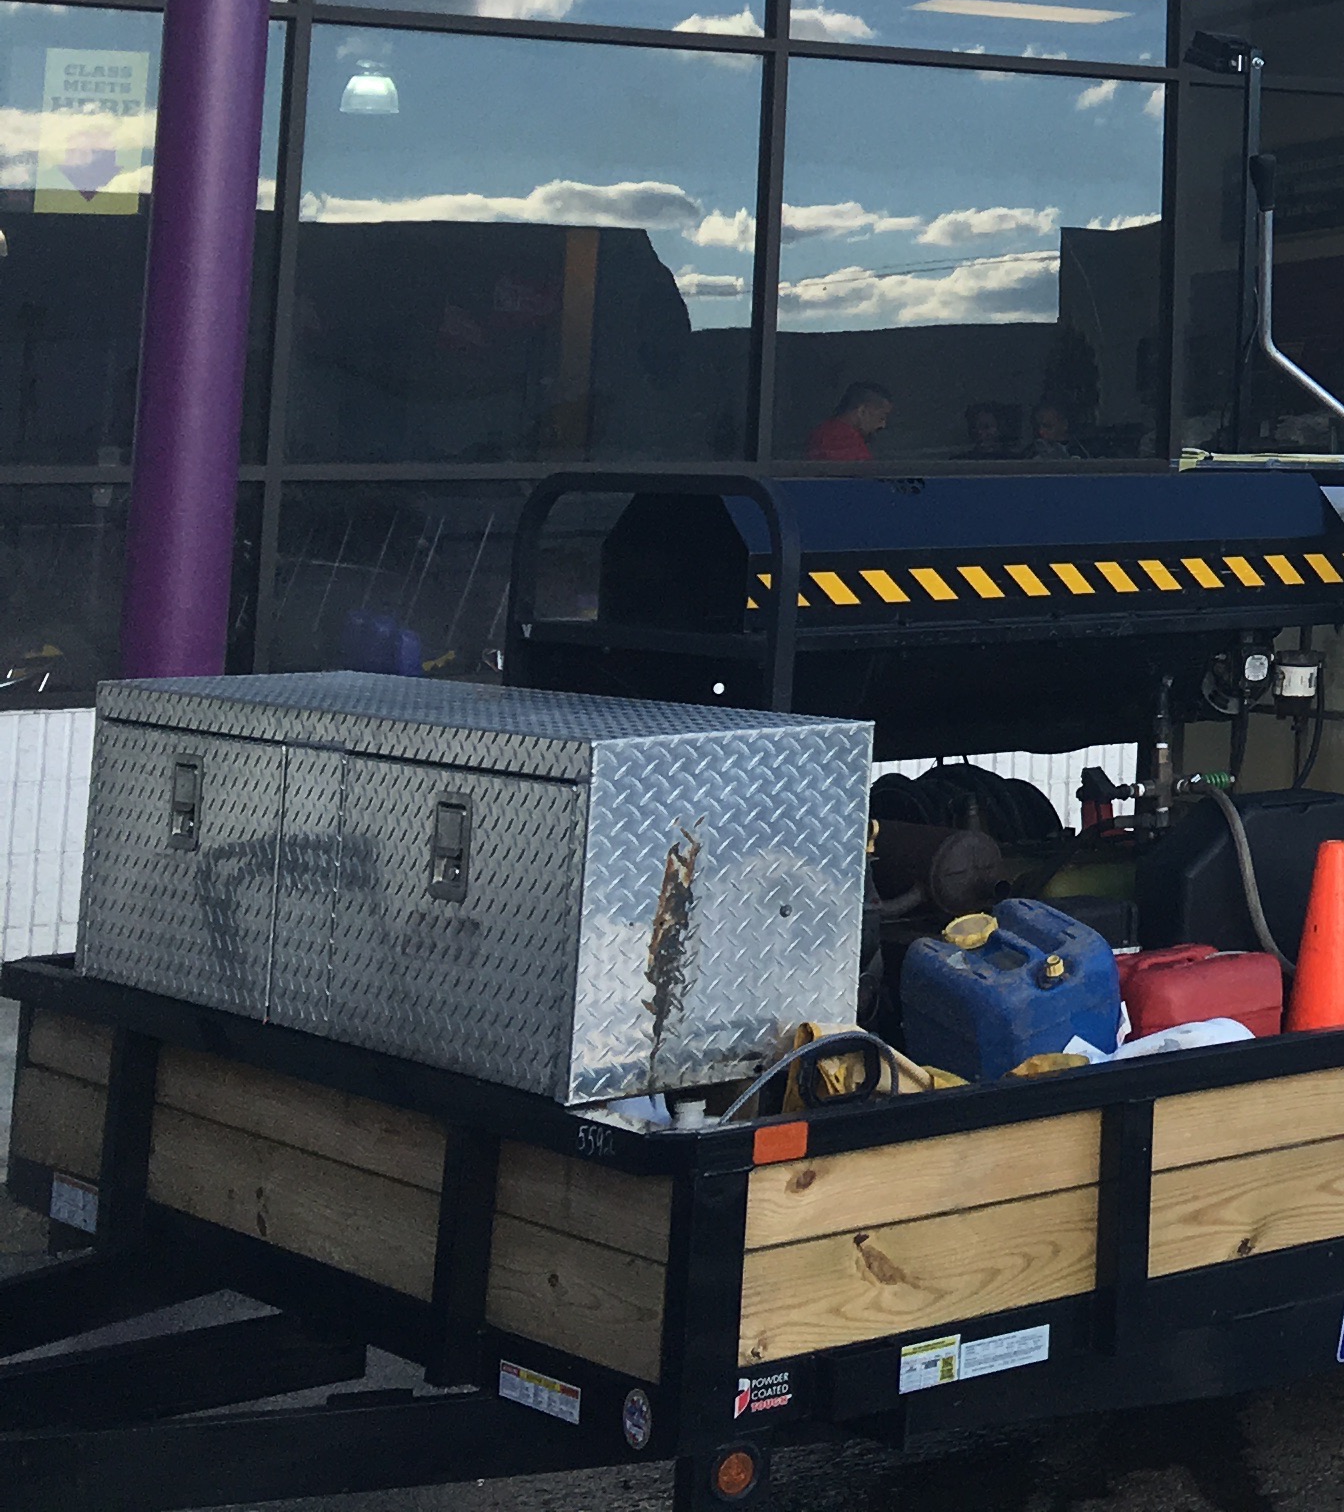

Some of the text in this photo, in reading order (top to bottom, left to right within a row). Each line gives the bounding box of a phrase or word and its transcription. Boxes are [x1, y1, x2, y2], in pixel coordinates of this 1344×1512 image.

[64, 63, 133, 79] CLASS
[63, 79, 132, 94] MEETS
[752, 1372, 789, 1389] POWDER
[751, 1384, 789, 1400] COATED
